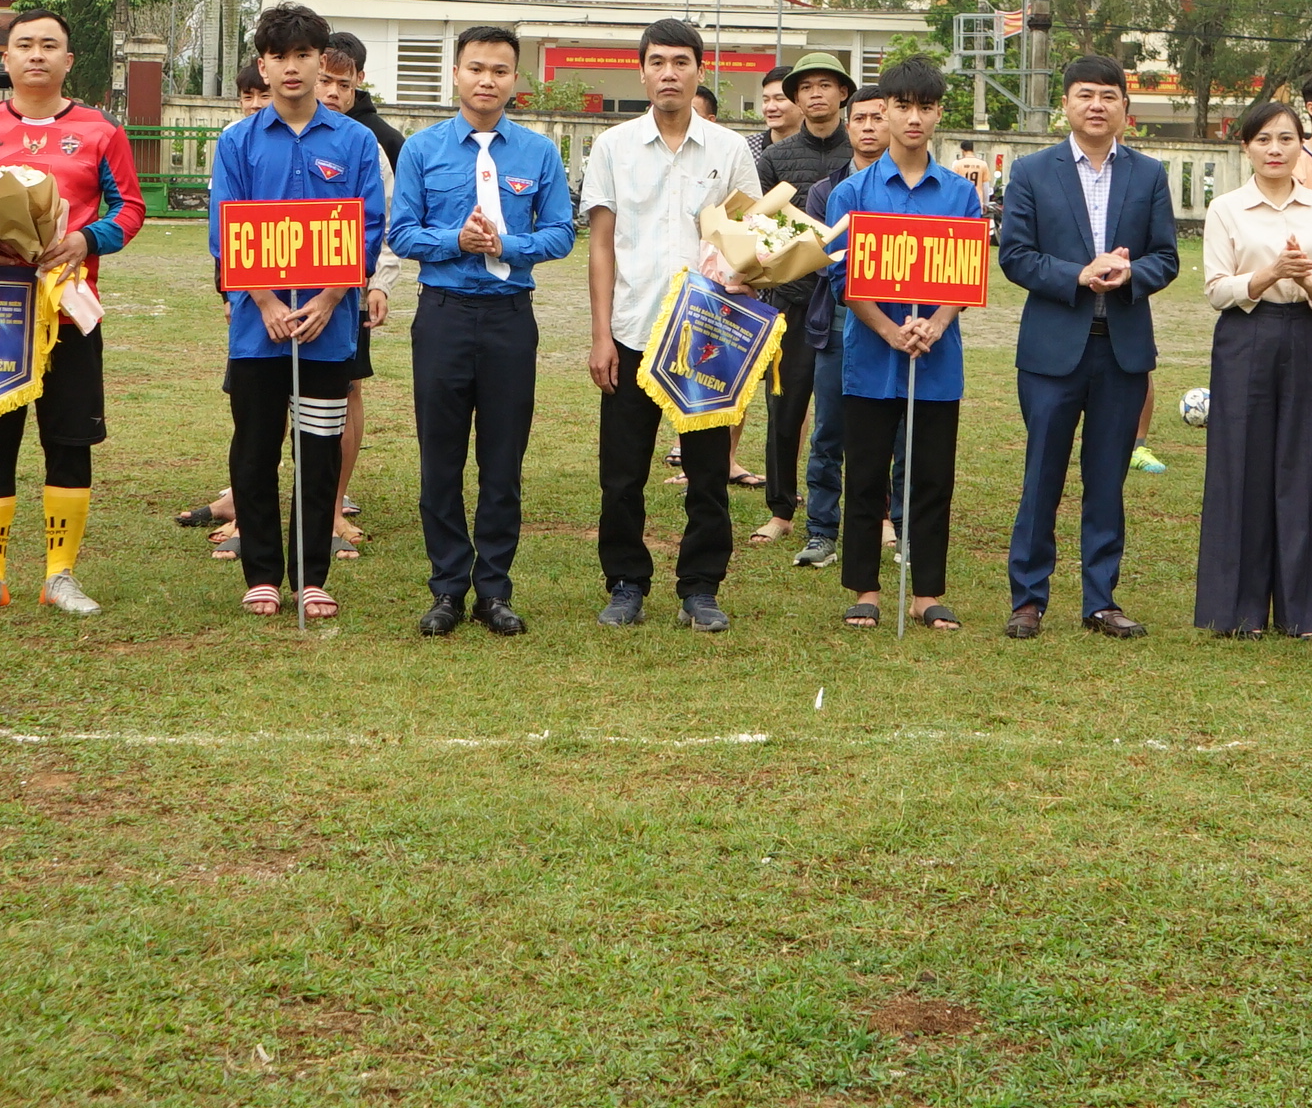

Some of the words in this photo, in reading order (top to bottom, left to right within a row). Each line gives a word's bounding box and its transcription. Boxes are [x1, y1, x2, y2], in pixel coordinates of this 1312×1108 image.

[229, 222, 255, 269] FC
[261, 216, 304, 278] HỢP
[310, 205, 356, 266] TIẾN
[853, 233, 876, 280] FC
[880, 231, 918, 291] HỢP
[923, 228, 982, 285] THÀNH
[695, 372, 726, 393] NIỆM
